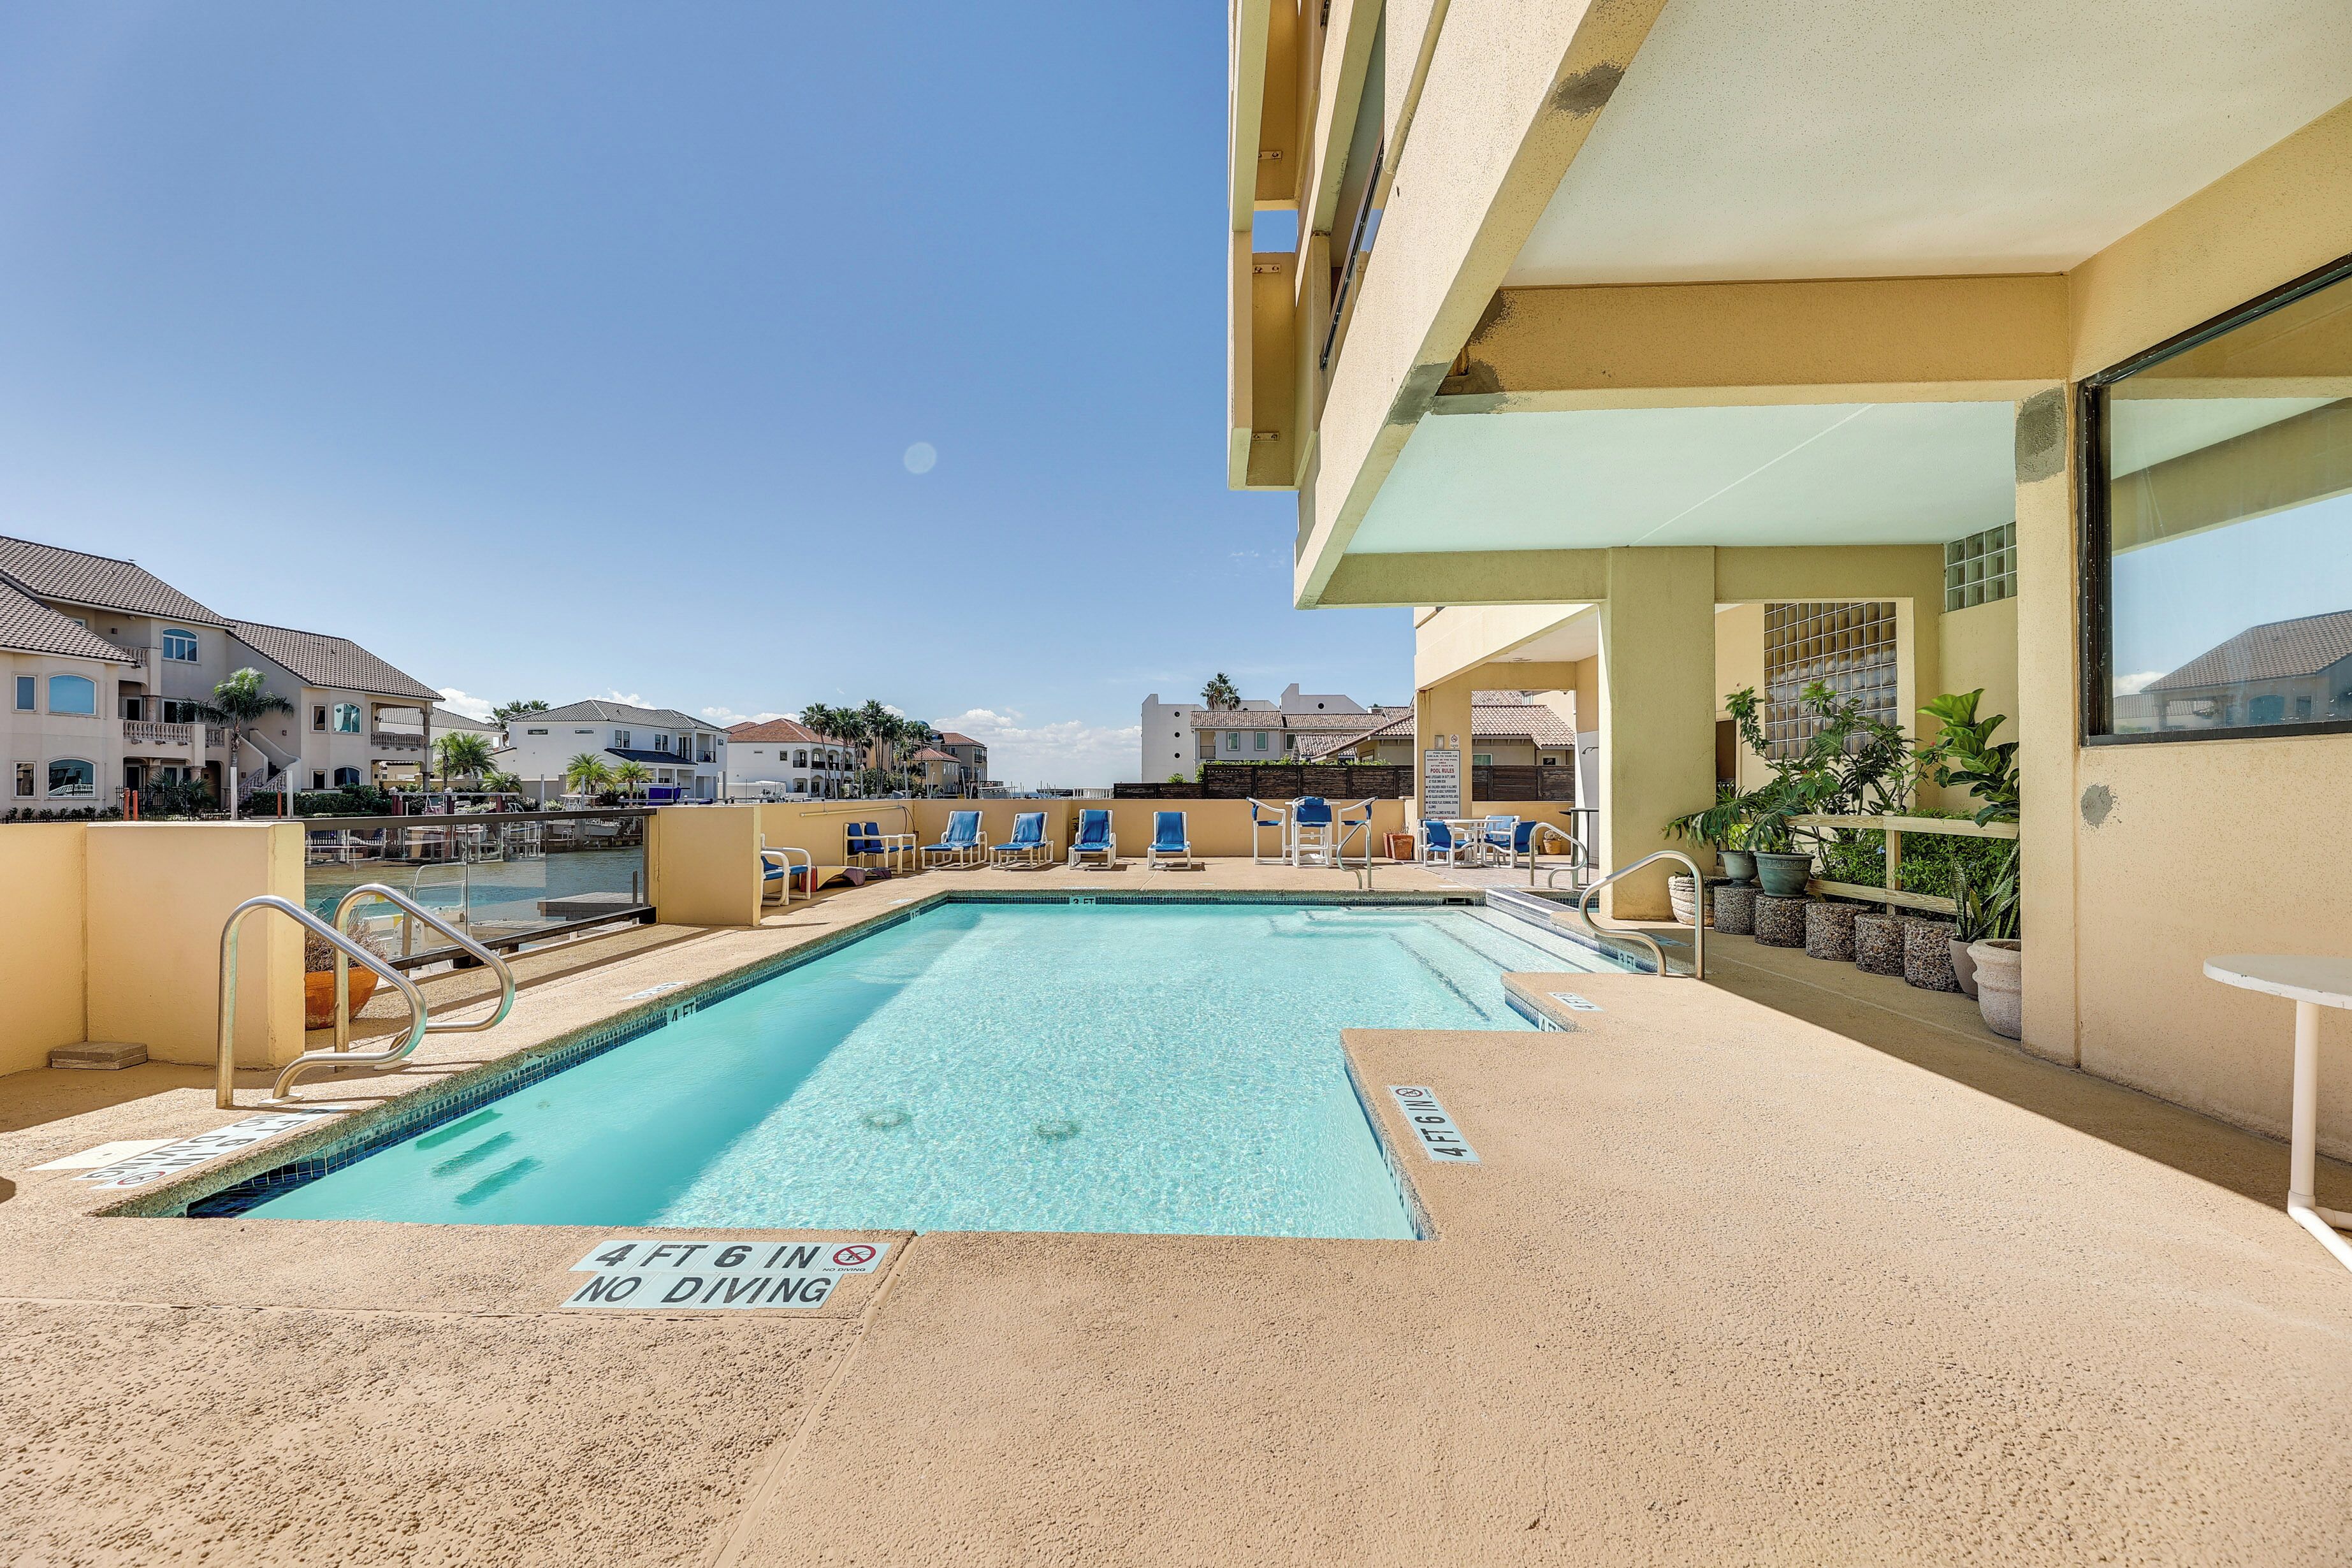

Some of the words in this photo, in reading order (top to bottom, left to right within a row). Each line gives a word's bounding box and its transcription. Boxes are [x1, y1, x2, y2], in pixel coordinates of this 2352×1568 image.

[1620, 953, 1624, 963] 3
[1627, 955, 1634, 967] FT
[671, 1009, 678, 1022] 4
[683, 1003, 694, 1019] FT
[1404, 1100, 1439, 1111] IN
[231, 1115, 287, 1128] NO
[255, 1119, 309, 1133] FT
[215, 1138, 257, 1147] 6
[1420, 1128, 1461, 1143] FT
[81, 1135, 231, 1179] DIVING
[158, 1152, 219, 1166] IN
[1433, 1147, 1467, 1157] 4
[595, 1244, 637, 1267] 4
[639, 1244, 708, 1268] FT
[714, 1245, 752, 1268] 6
[764, 1245, 821, 1269] IN
[572, 1275, 642, 1302] NO
[661, 1277, 831, 1303] DIVING
